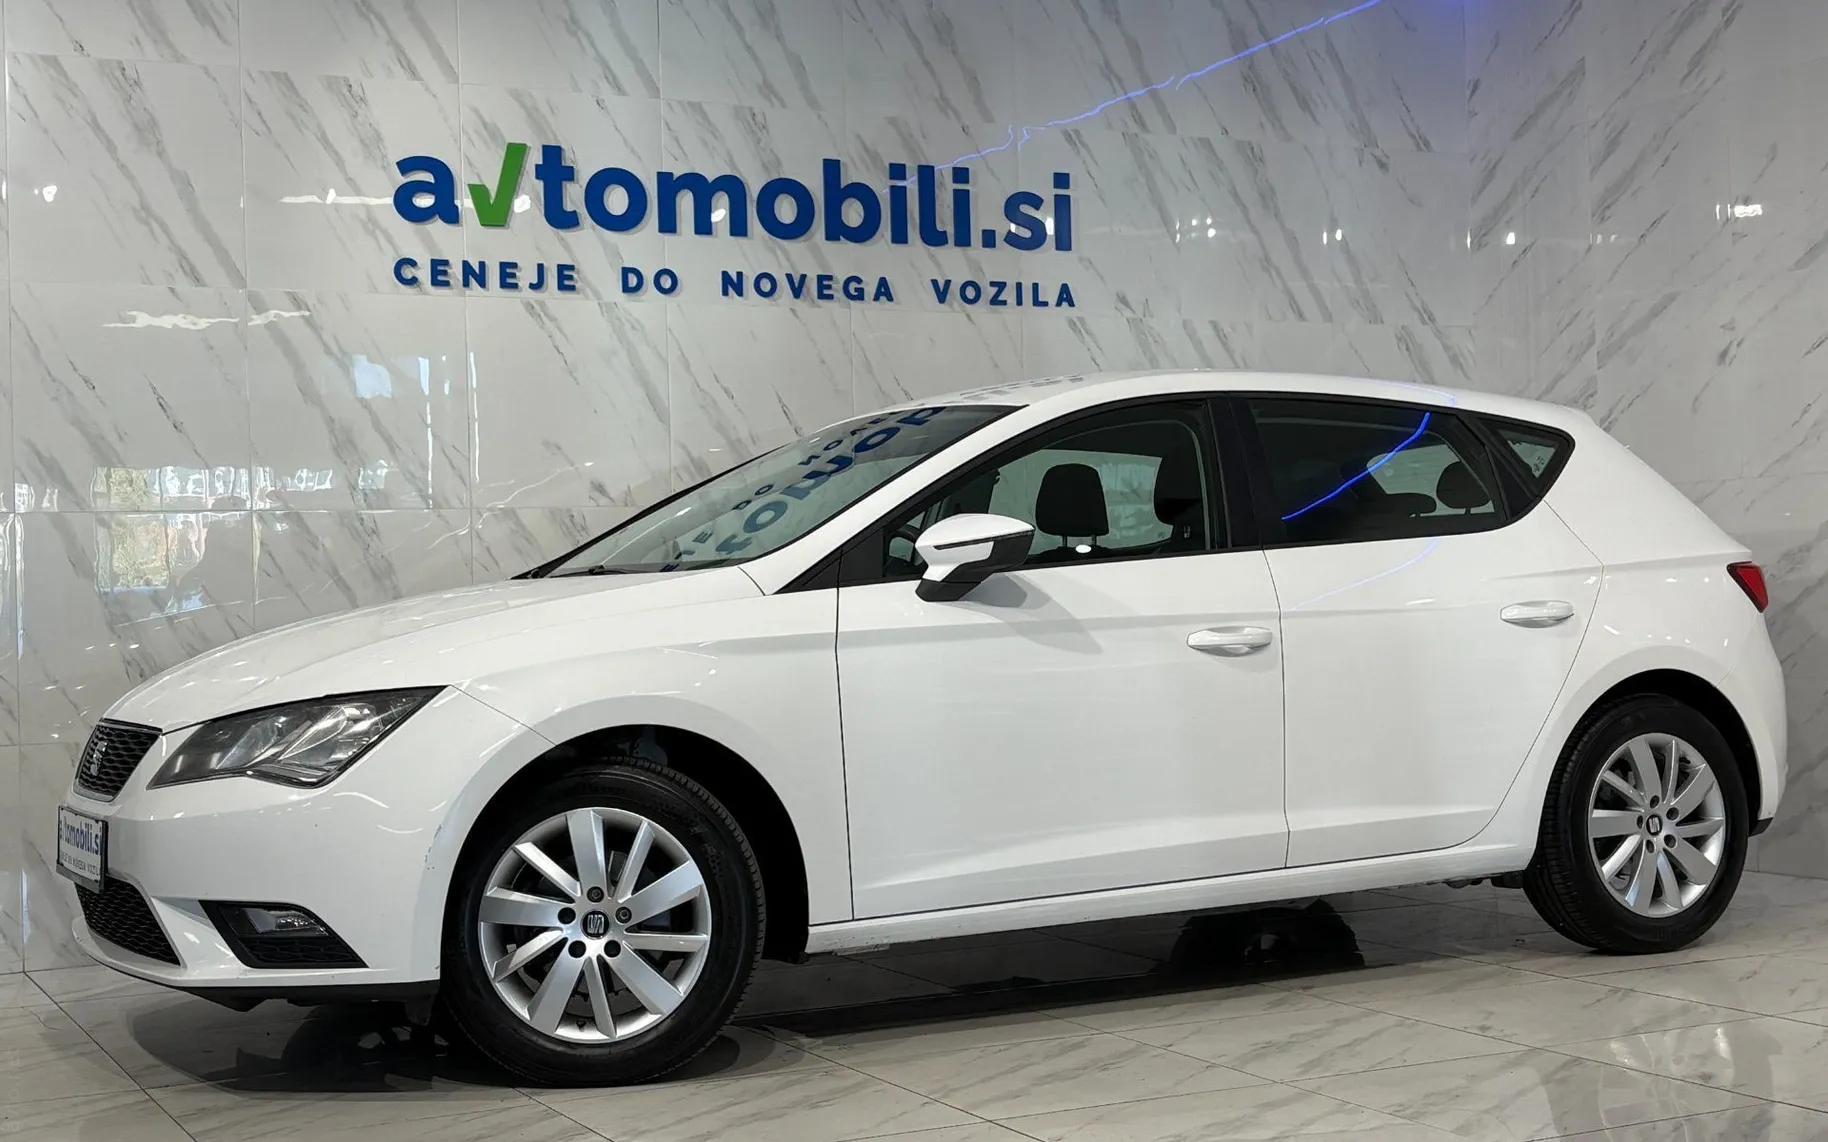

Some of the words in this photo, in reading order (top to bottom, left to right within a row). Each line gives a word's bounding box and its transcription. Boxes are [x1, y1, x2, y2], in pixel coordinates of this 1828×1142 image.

[393, 142, 1073, 253] avtomobili.si
[393, 256, 578, 291] CENEJE
[621, 267, 679, 294] DO
[722, 270, 894, 302] NOVEGA
[931, 279, 1075, 308] VOZILA
